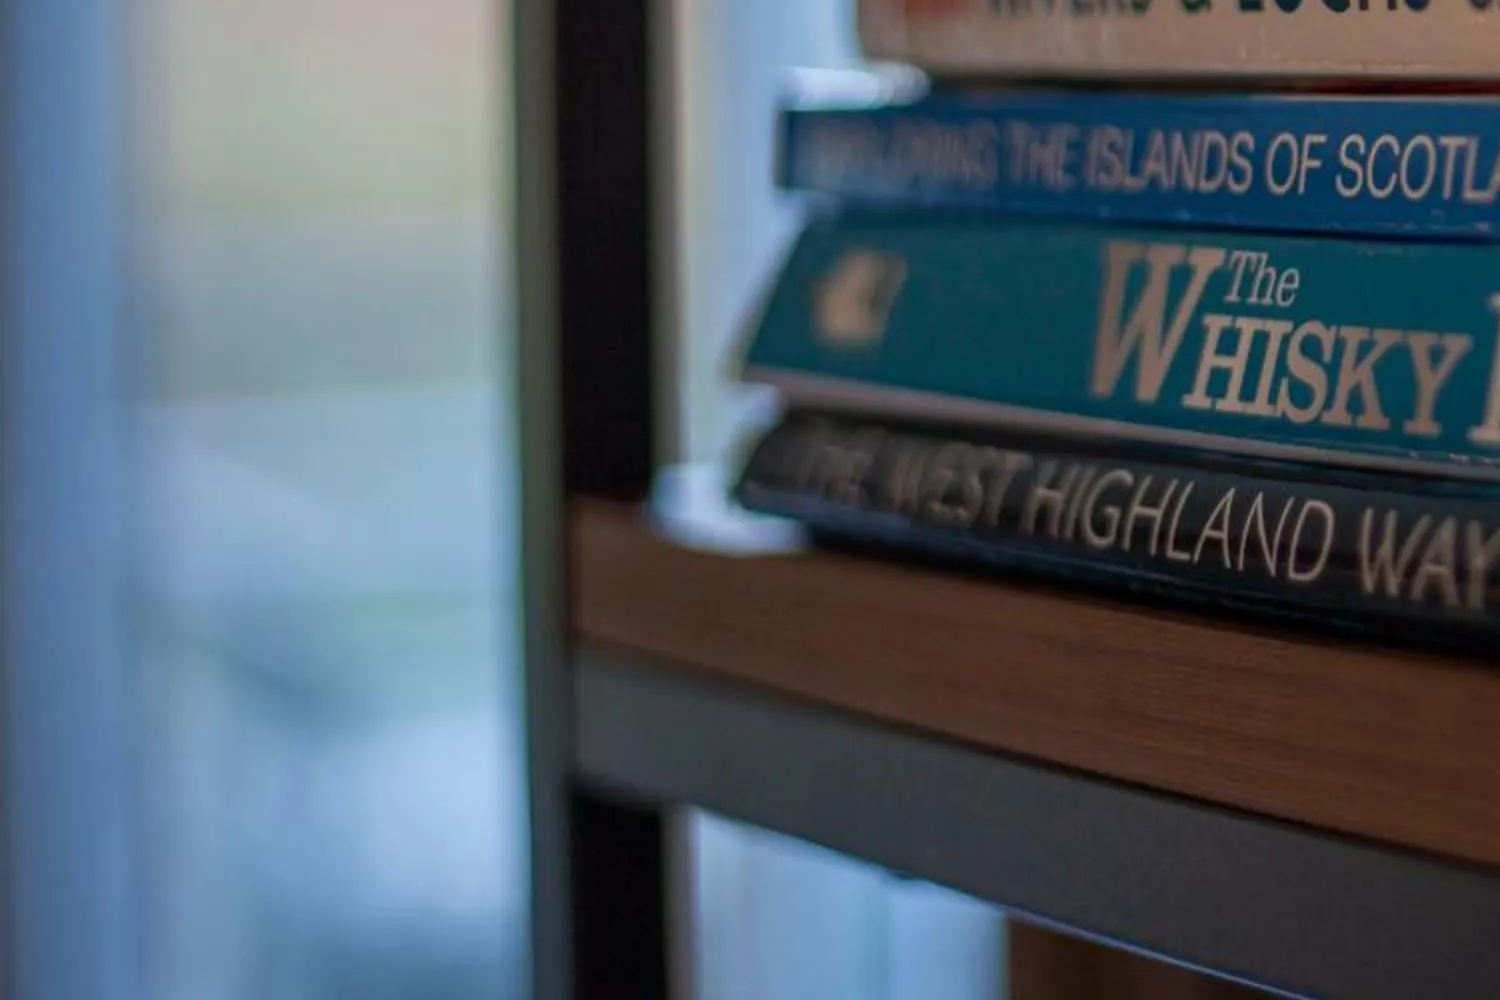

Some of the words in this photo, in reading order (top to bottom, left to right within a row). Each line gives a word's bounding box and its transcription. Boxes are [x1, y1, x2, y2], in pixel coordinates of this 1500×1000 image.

[1006, 122, 1079, 190] THE
[1083, 127, 1255, 193] ISLANDS
[1264, 133, 1326, 195] OF
[1224, 249, 1301, 306] The
[1091, 241, 1470, 437] WHISKY
[884, 438, 1032, 528] WEST
[1023, 458, 1336, 584] HIGHLAND
